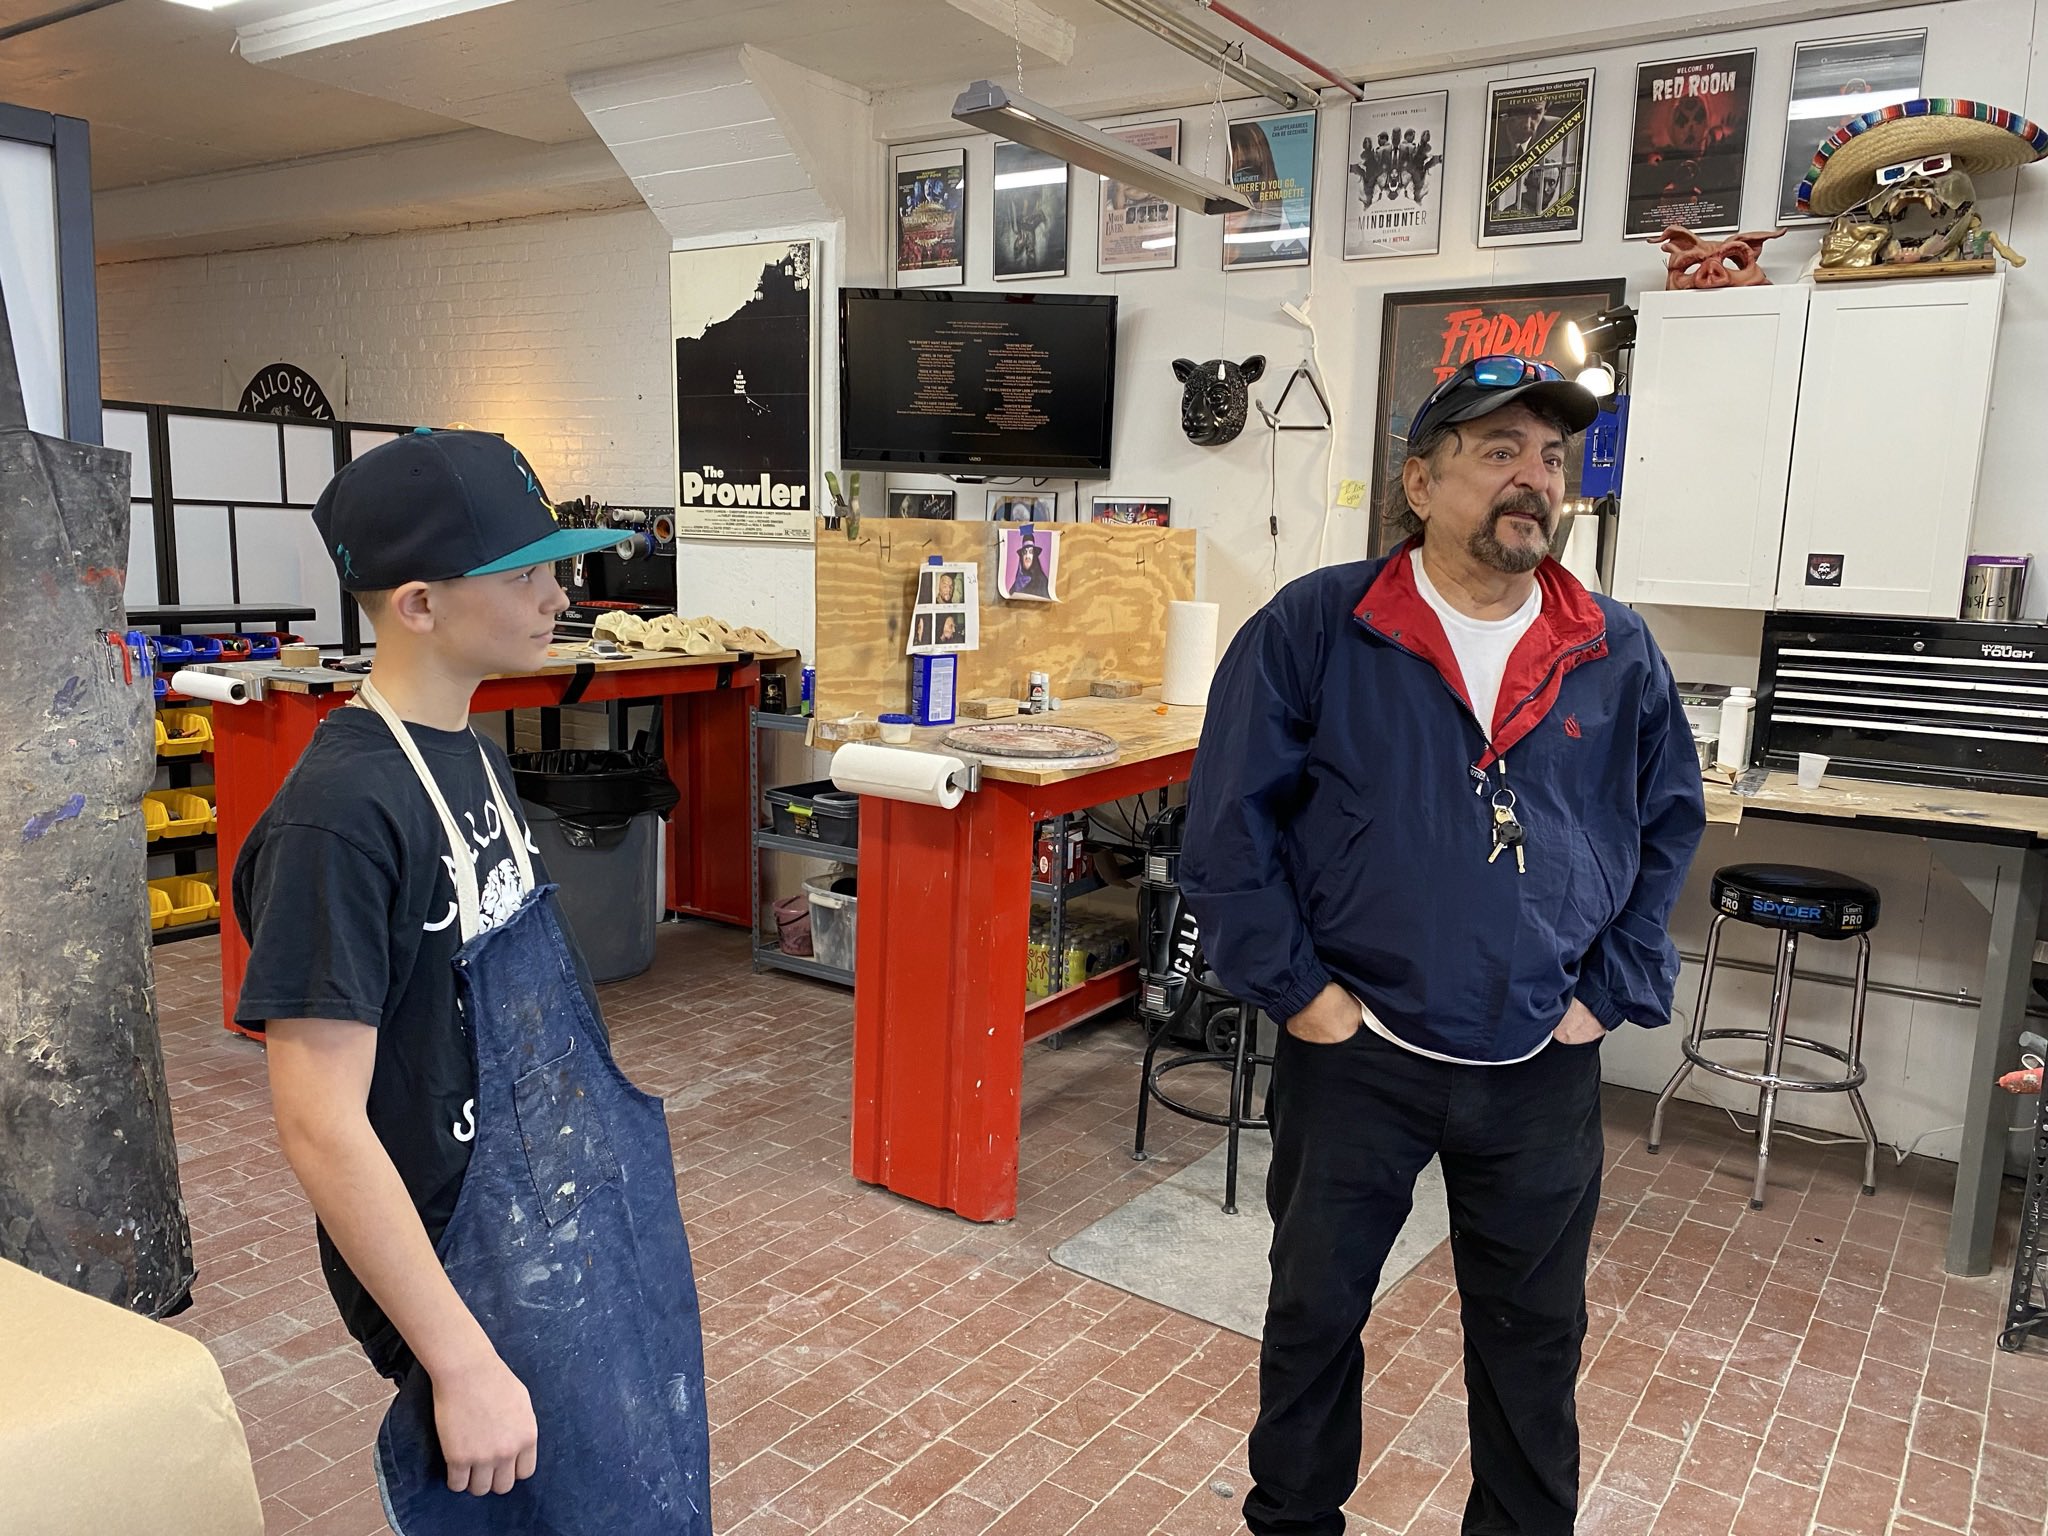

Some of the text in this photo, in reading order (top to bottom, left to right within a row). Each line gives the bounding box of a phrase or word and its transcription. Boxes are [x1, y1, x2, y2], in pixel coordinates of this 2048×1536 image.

[1677, 63, 1714, 74] WELCOME TO
[1528, 86, 1545, 94] going
[1652, 71, 1737, 102] RED ROOM
[1490, 111, 1582, 195] The Final Interview
[1232, 177, 1297, 193] WHERE'D YOU GO,
[1259, 187, 1305, 201] BERNADETTE
[1358, 210, 1427, 230] MINDHUNTER
[1440, 308, 1561, 364] FRIDAY
[703, 466, 724, 479] The
[682, 472, 806, 508] Prowler
[1981, 648, 2034, 659] TOUGH
[1721, 896, 1739, 910] PRO
[1752, 899, 1821, 919] SPYDER
[1842, 914, 1863, 925] PRO
